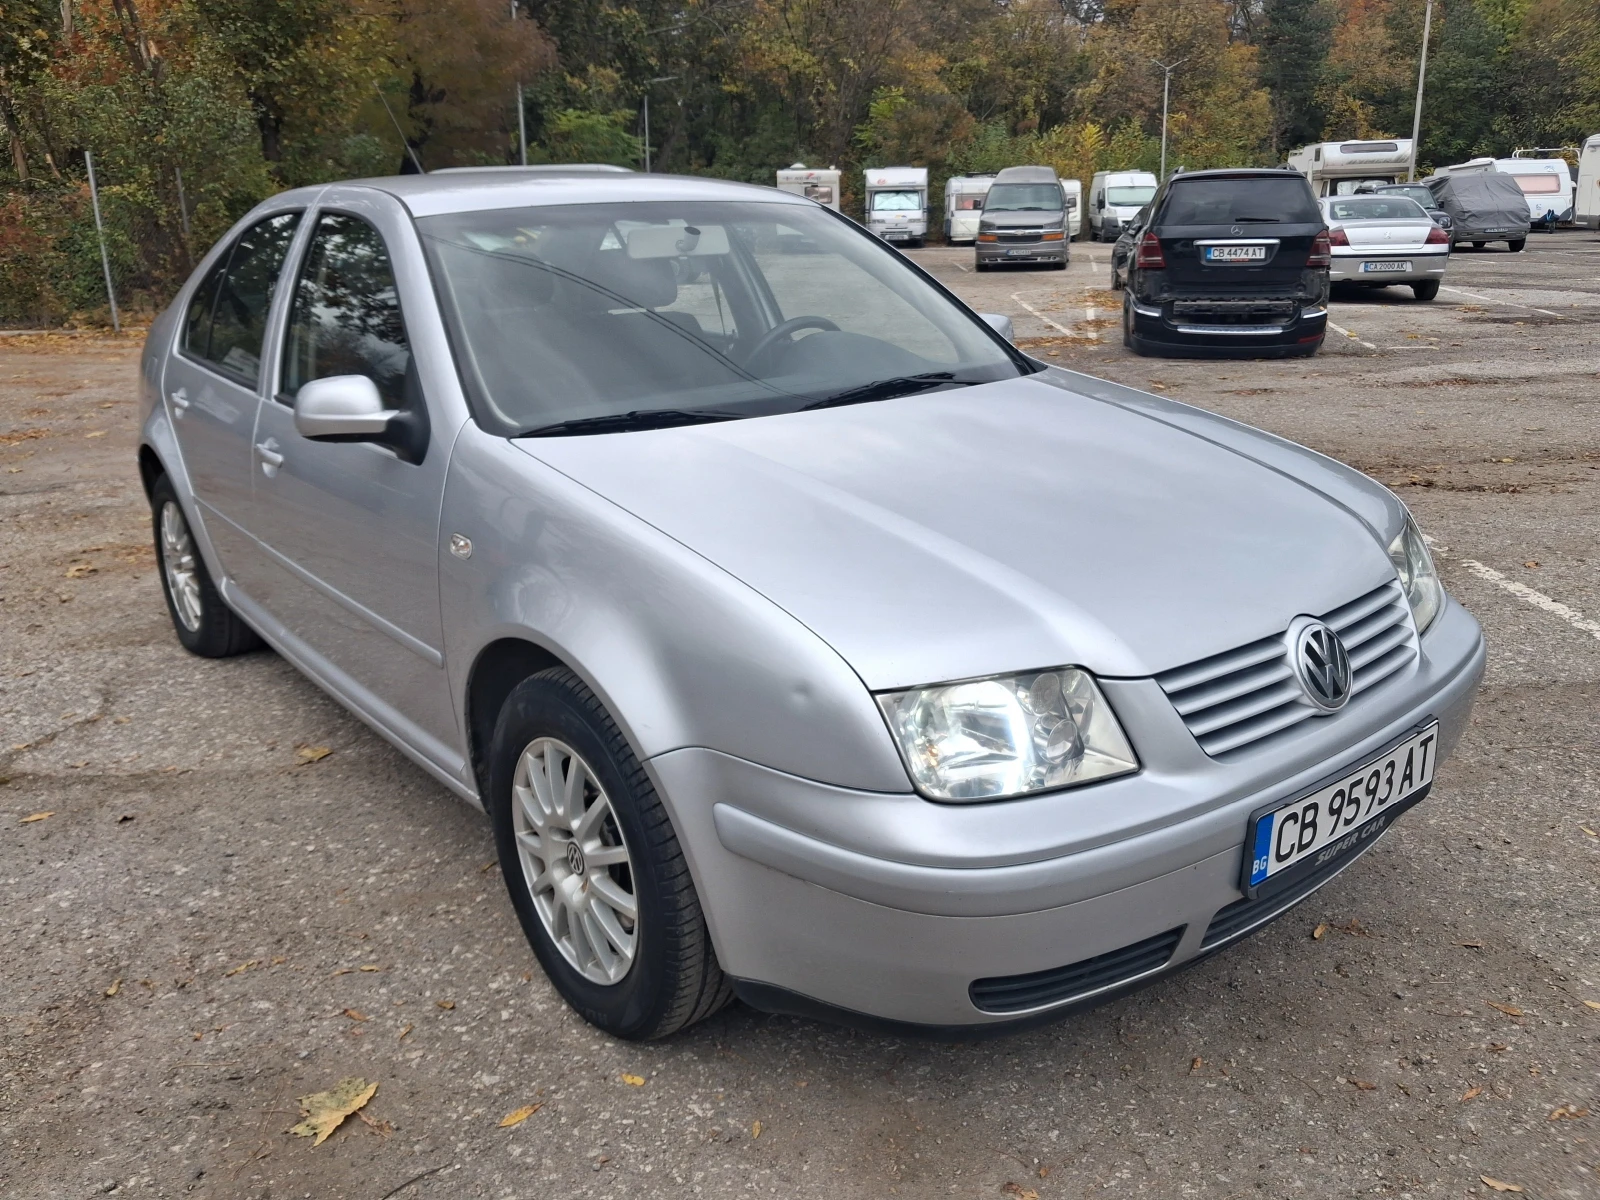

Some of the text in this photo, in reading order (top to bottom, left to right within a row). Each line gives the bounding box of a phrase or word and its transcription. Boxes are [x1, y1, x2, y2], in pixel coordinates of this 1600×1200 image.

[1212, 247, 1263, 258] CB 4474 AT
[1275, 733, 1434, 863] CB 9593 AT
[1315, 815, 1386, 865] SUPER CAR
[1252, 856, 1267, 874] BG
